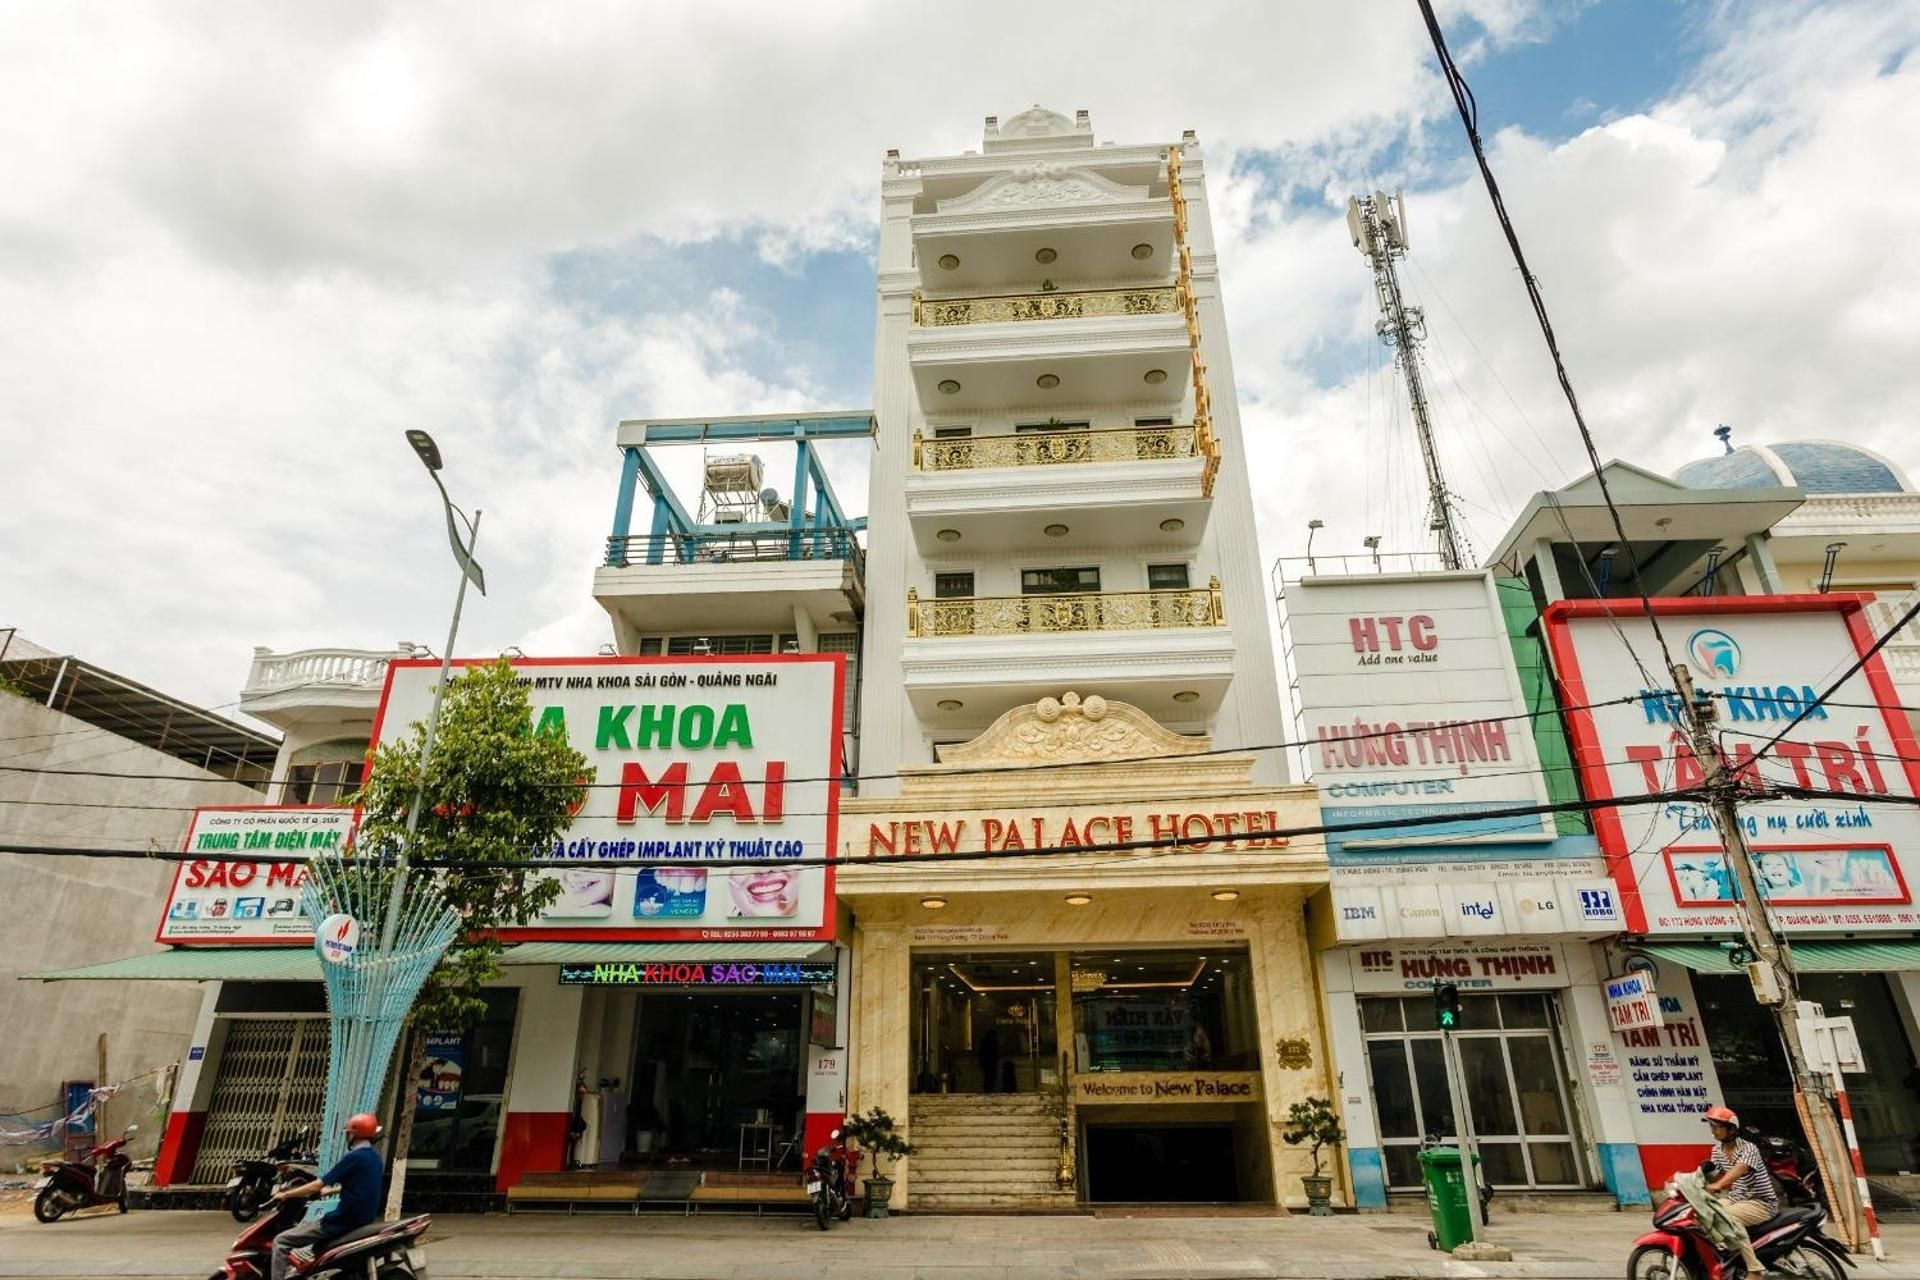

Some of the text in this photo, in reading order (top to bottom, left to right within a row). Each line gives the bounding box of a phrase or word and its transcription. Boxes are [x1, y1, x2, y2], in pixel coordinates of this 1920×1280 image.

[1349, 615, 1438, 653] HTC
[1357, 652, 1438, 666] Add one value
[535, 677, 565, 689] MTV
[566, 677, 592, 688] NHA
[597, 676, 630, 688] KHOA
[697, 671, 741, 687] QUẢNG
[745, 672, 777, 687] NGÃI
[1724, 685, 1828, 722] KHOA
[595, 704, 754, 750] KHOA
[1776, 725, 1887, 795] TRÍ
[617, 760, 788, 824] MAI
[1328, 778, 1455, 798] COMPUTER
[1767, 815, 1787, 834] nụ
[1834, 805, 1872, 828] xinh
[197, 832, 240, 849] TRUNG
[243, 829, 273, 849] TÂM
[274, 829, 308, 850] ĐIỆN
[868, 811, 1290, 857] NEW PALACE HOTEL
[599, 838, 636, 858] GHÉP
[638, 840, 702, 858] IMPLANT
[774, 840, 803, 857] CAO
[185, 859, 257, 888] SAO
[1343, 906, 1440, 920] IBM Canon
[1461, 901, 1554, 919] intel LG
[1585, 908, 1613, 916] ROBO
[594, 963, 801, 984] NHA KHOA SAO MAI
[1360, 951, 1556, 981] HTC HƯNG THỊNH
[1608, 979, 1642, 999] NHA KHOA
[1664, 1016, 1700, 1047] TRÍ
[818, 1059, 836, 1069] 179
[1671, 1072, 1703, 1081] IMPLANT
[1084, 1080, 1250, 1097] Welcome to New Palace
[1641, 1104, 1656, 1113] NHA
[1657, 1103, 1675, 1113] KHOA
